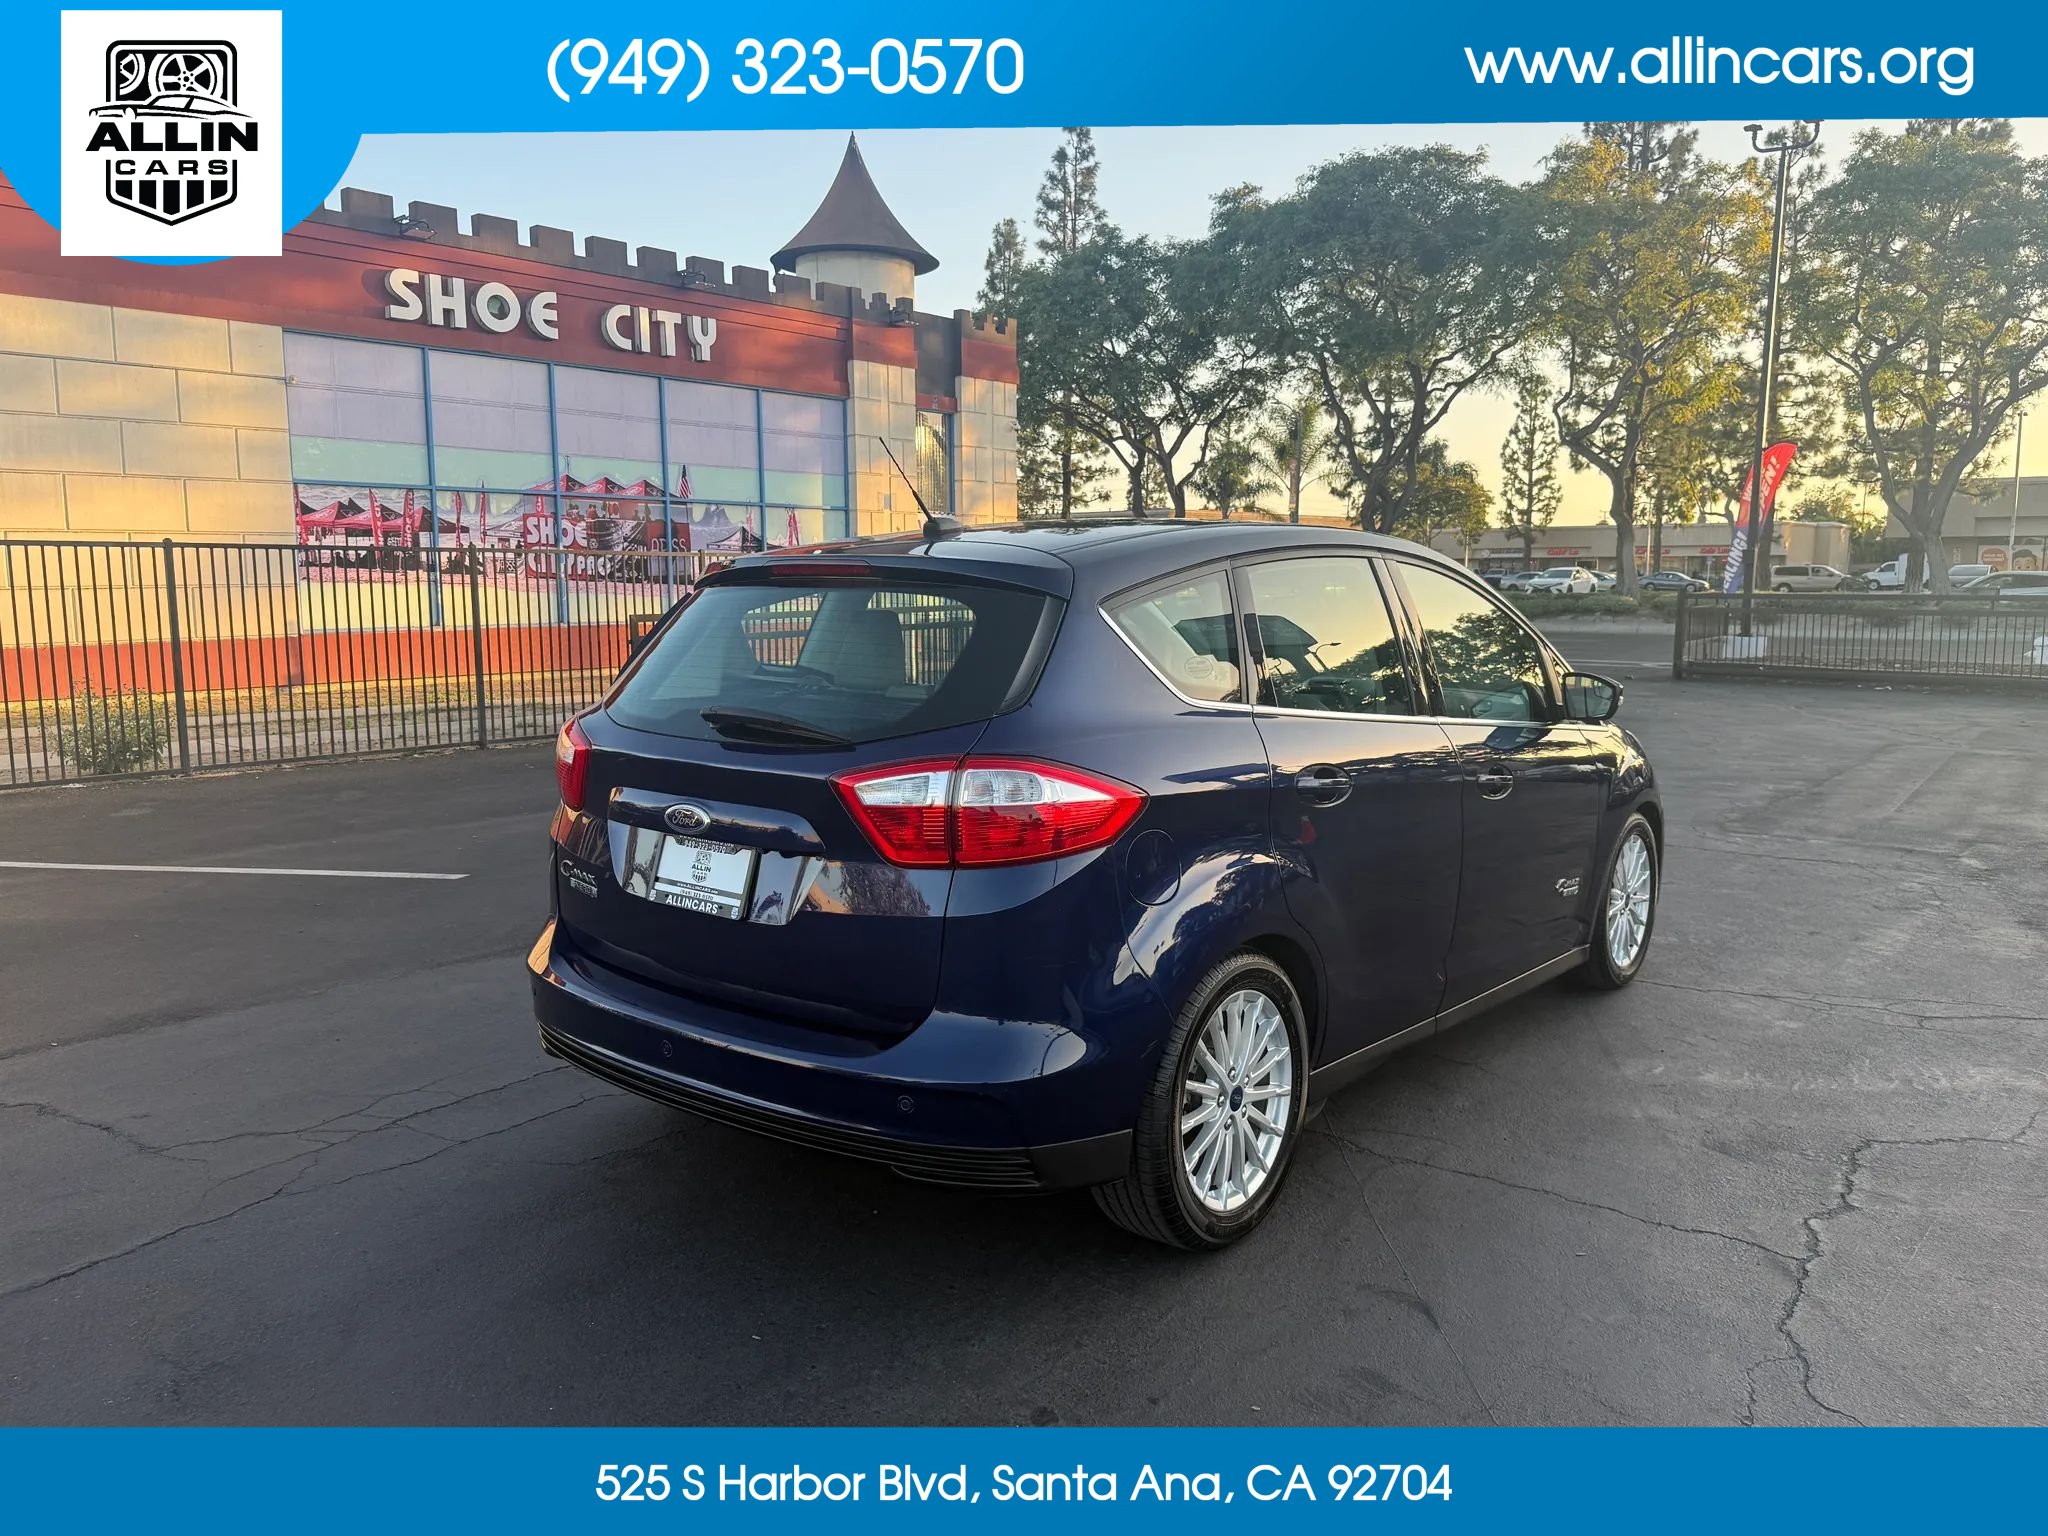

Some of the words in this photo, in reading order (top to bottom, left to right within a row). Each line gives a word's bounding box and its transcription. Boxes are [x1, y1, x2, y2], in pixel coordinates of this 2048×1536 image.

[384, 268, 559, 341] SHOE
[601, 304, 717, 362] CITY
[526, 516, 588, 548] SHOE
[672, 808, 699, 827] Ford
[691, 863, 712, 873] ALLIN
[665, 894, 719, 915] ALLINCARS
